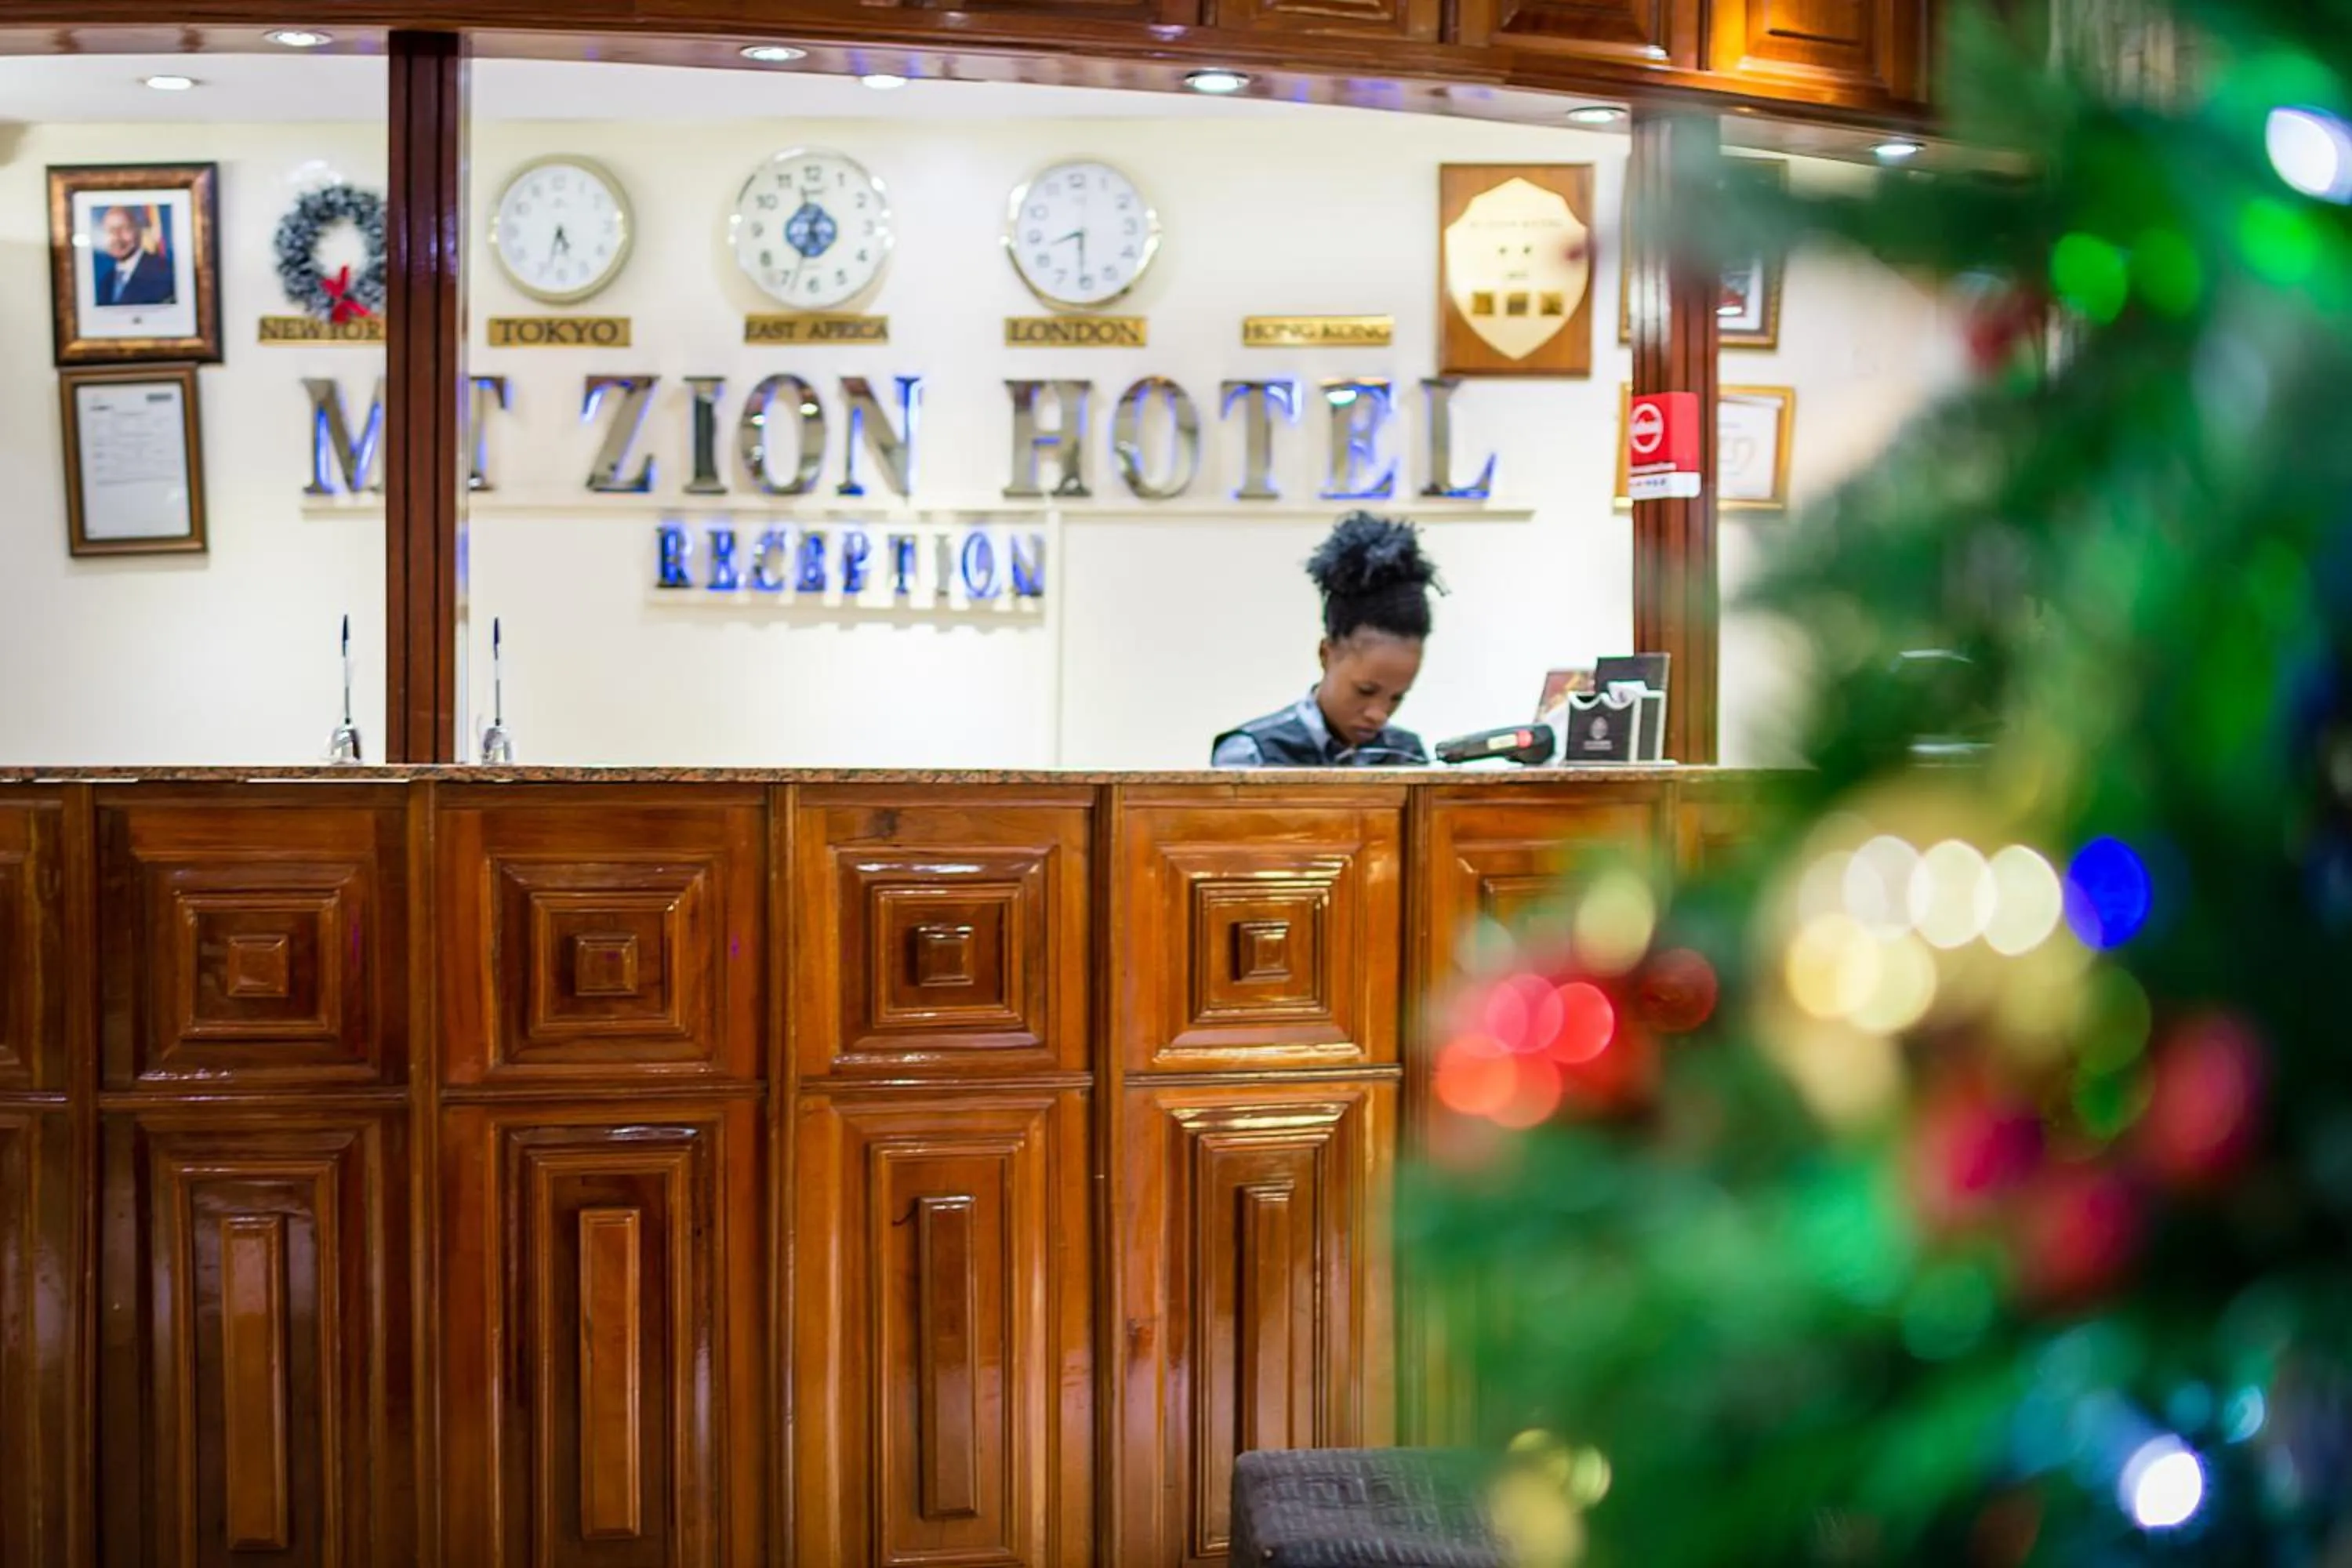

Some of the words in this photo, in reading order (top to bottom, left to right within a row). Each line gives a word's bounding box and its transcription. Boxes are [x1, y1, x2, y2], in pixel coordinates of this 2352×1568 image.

[260, 318, 326, 339] NEW
[496, 319, 619, 344] TOKYO
[746, 321, 797, 340] EAST
[807, 321, 888, 340] AFRICA
[1011, 322, 1140, 342] LONDON
[582, 373, 923, 501] ZION
[1002, 376, 1496, 500] HOTEL
[655, 524, 1045, 597] RECEPTION
